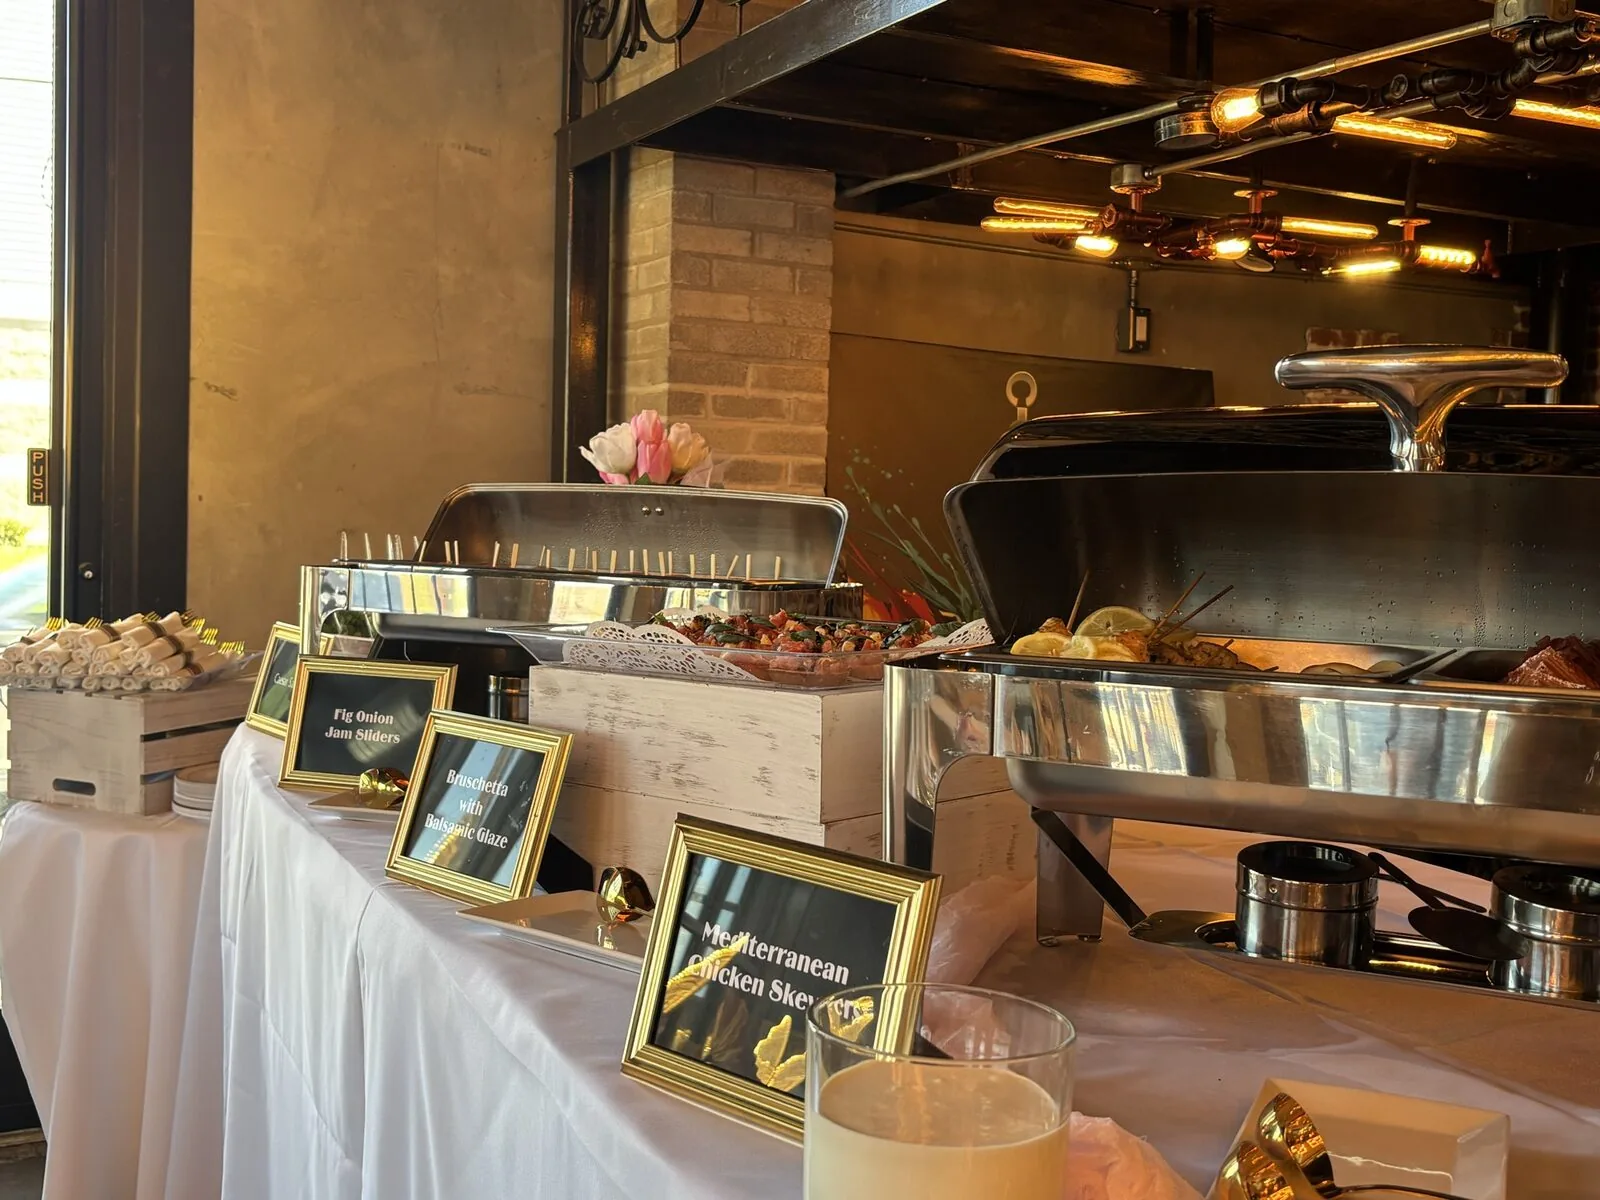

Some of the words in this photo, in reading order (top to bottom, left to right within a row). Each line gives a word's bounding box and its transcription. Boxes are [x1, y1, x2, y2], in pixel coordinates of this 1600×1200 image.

[32, 451, 44, 503] PUSH
[333, 708, 354, 724] Fig
[356, 710, 394, 725] Onion
[324, 726, 353, 740] Jam
[355, 728, 401, 744] Sliders
[446, 769, 509, 797] Bruschetta
[459, 798, 483, 816] with
[424, 813, 475, 840] Balsamic
[476, 827, 508, 849] Glaze
